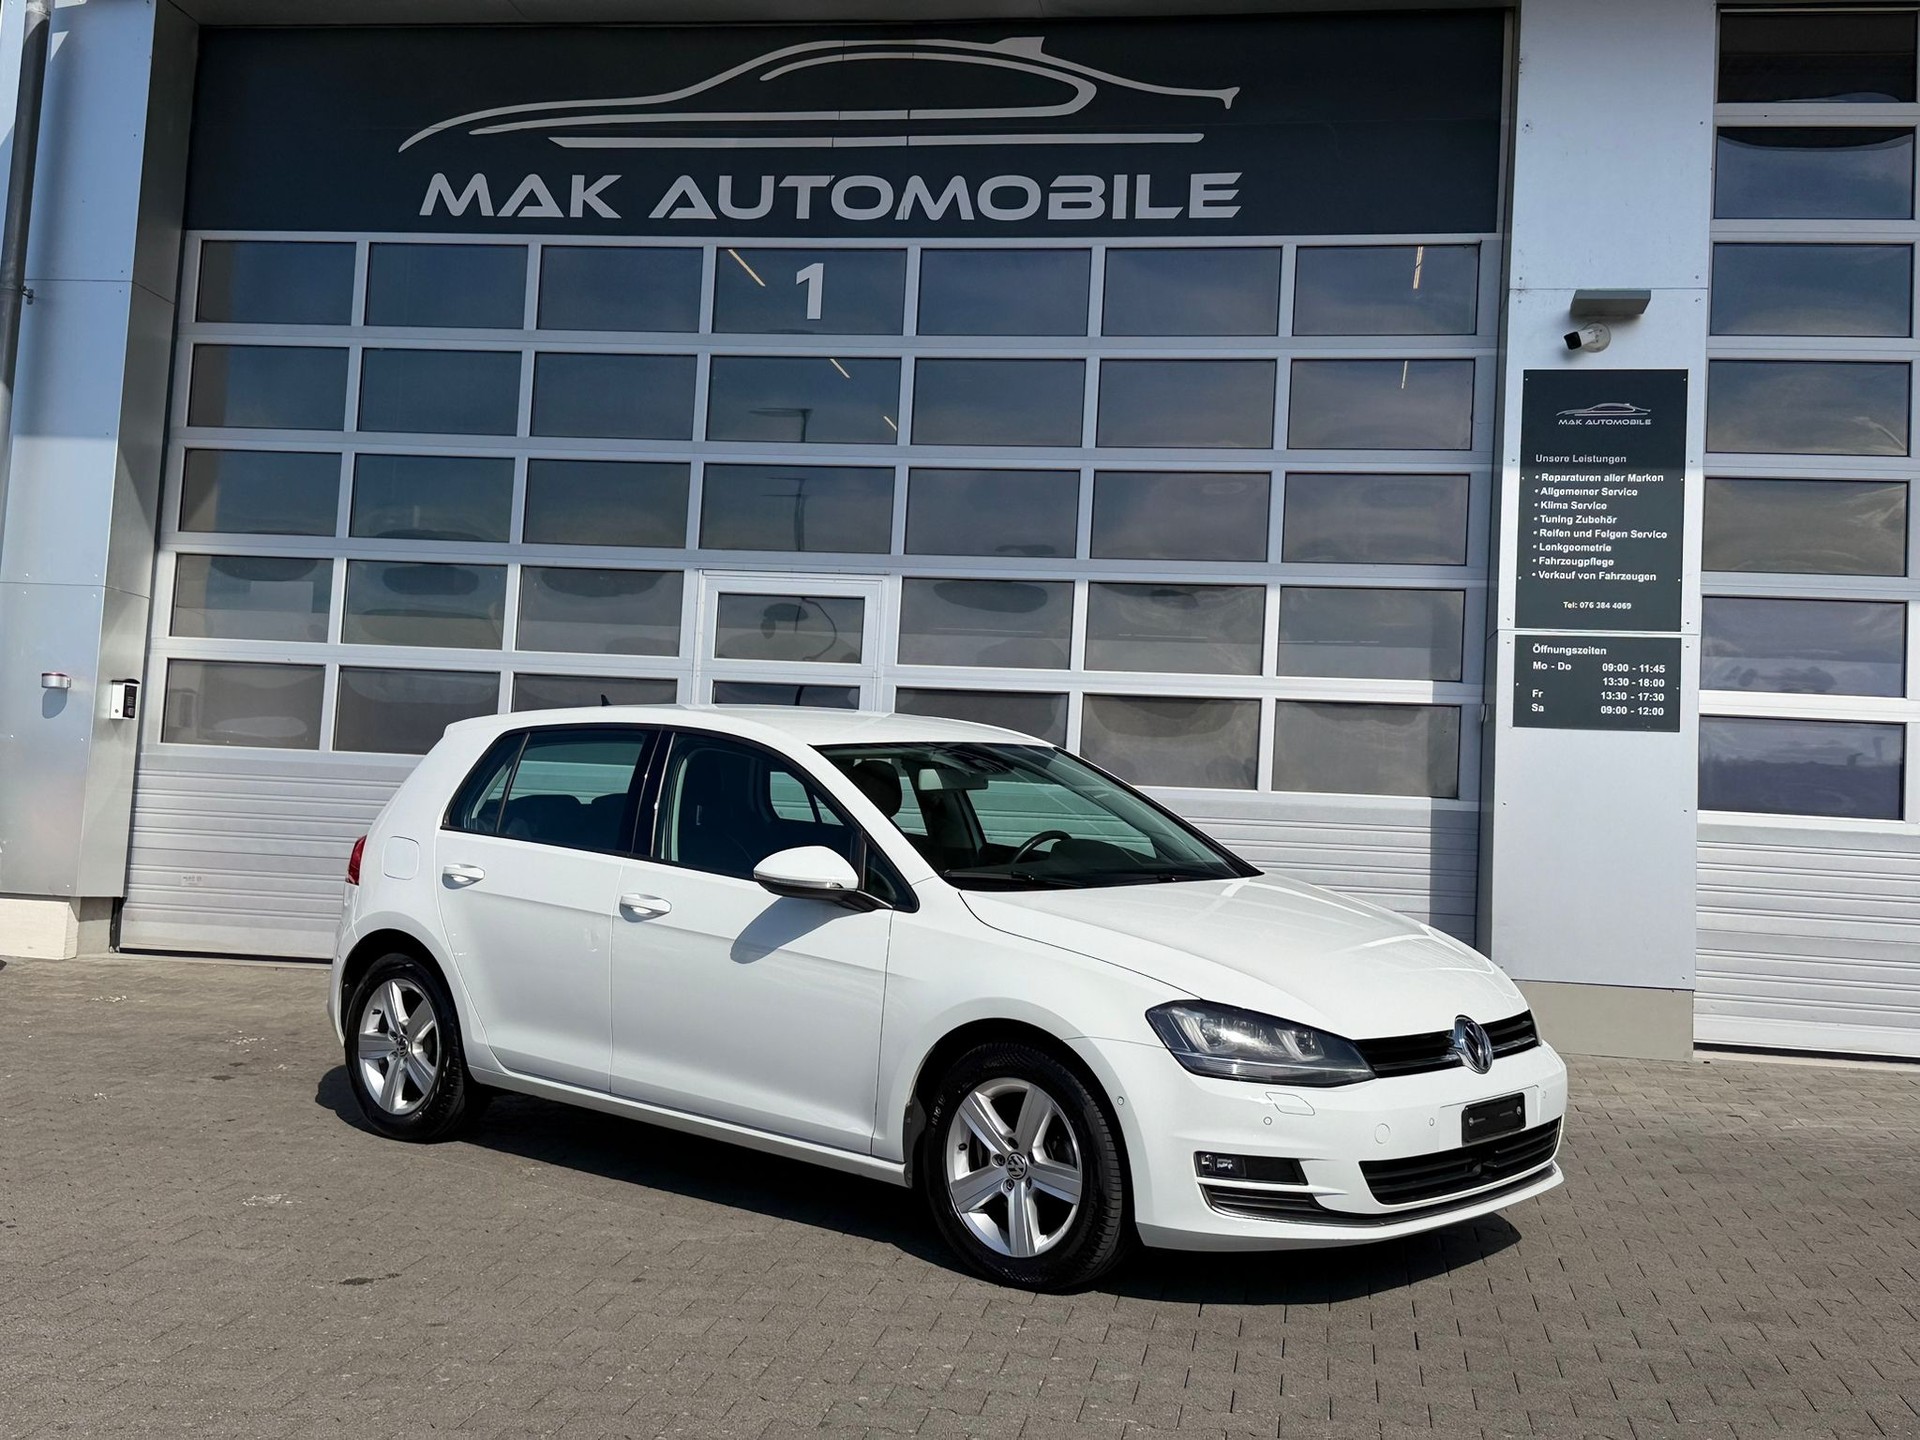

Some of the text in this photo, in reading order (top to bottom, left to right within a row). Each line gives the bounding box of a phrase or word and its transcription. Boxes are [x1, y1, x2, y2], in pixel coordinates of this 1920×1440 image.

[420, 172, 1242, 220] MAK AUTOMOBILE
[796, 263, 823, 319] 1
[1573, 455, 1626, 464] Leistungen
[1542, 473, 1663, 482] Reparaturen aller Marken
[1540, 487, 1637, 497] Allgemeiner Service
[1541, 501, 1607, 509] Klima Service
[1540, 515, 1617, 525] Tuning Zubehör
[1540, 529, 1570, 537] Reifen
[1595, 530, 1627, 539] Felgen
[1631, 530, 1667, 538] Service
[1540, 543, 1611, 552] Lenkgeometrie
[1539, 557, 1614, 567] Fahrzeugpflege
[1538, 571, 1575, 579] Verkauf
[1599, 572, 1656, 582] Fahrzeugen
[1533, 643, 1606, 656] Öffnungszeiten
[1533, 661, 1547, 669] Mo
[1558, 662, 1571, 670] Do
[1602, 663, 1628, 672] 09:00
[1640, 664, 1665, 673] 11:45
[1603, 678, 1629, 686] 13:30
[1639, 679, 1665, 687] 18:00
[1532, 689, 1543, 697] Fr
[1601, 692, 1627, 700] 13:30
[1638, 693, 1664, 701] 17:30
[1532, 703, 1544, 712] Sa
[1601, 706, 1627, 714] 09:00
[1638, 707, 1664, 715] 12:00
